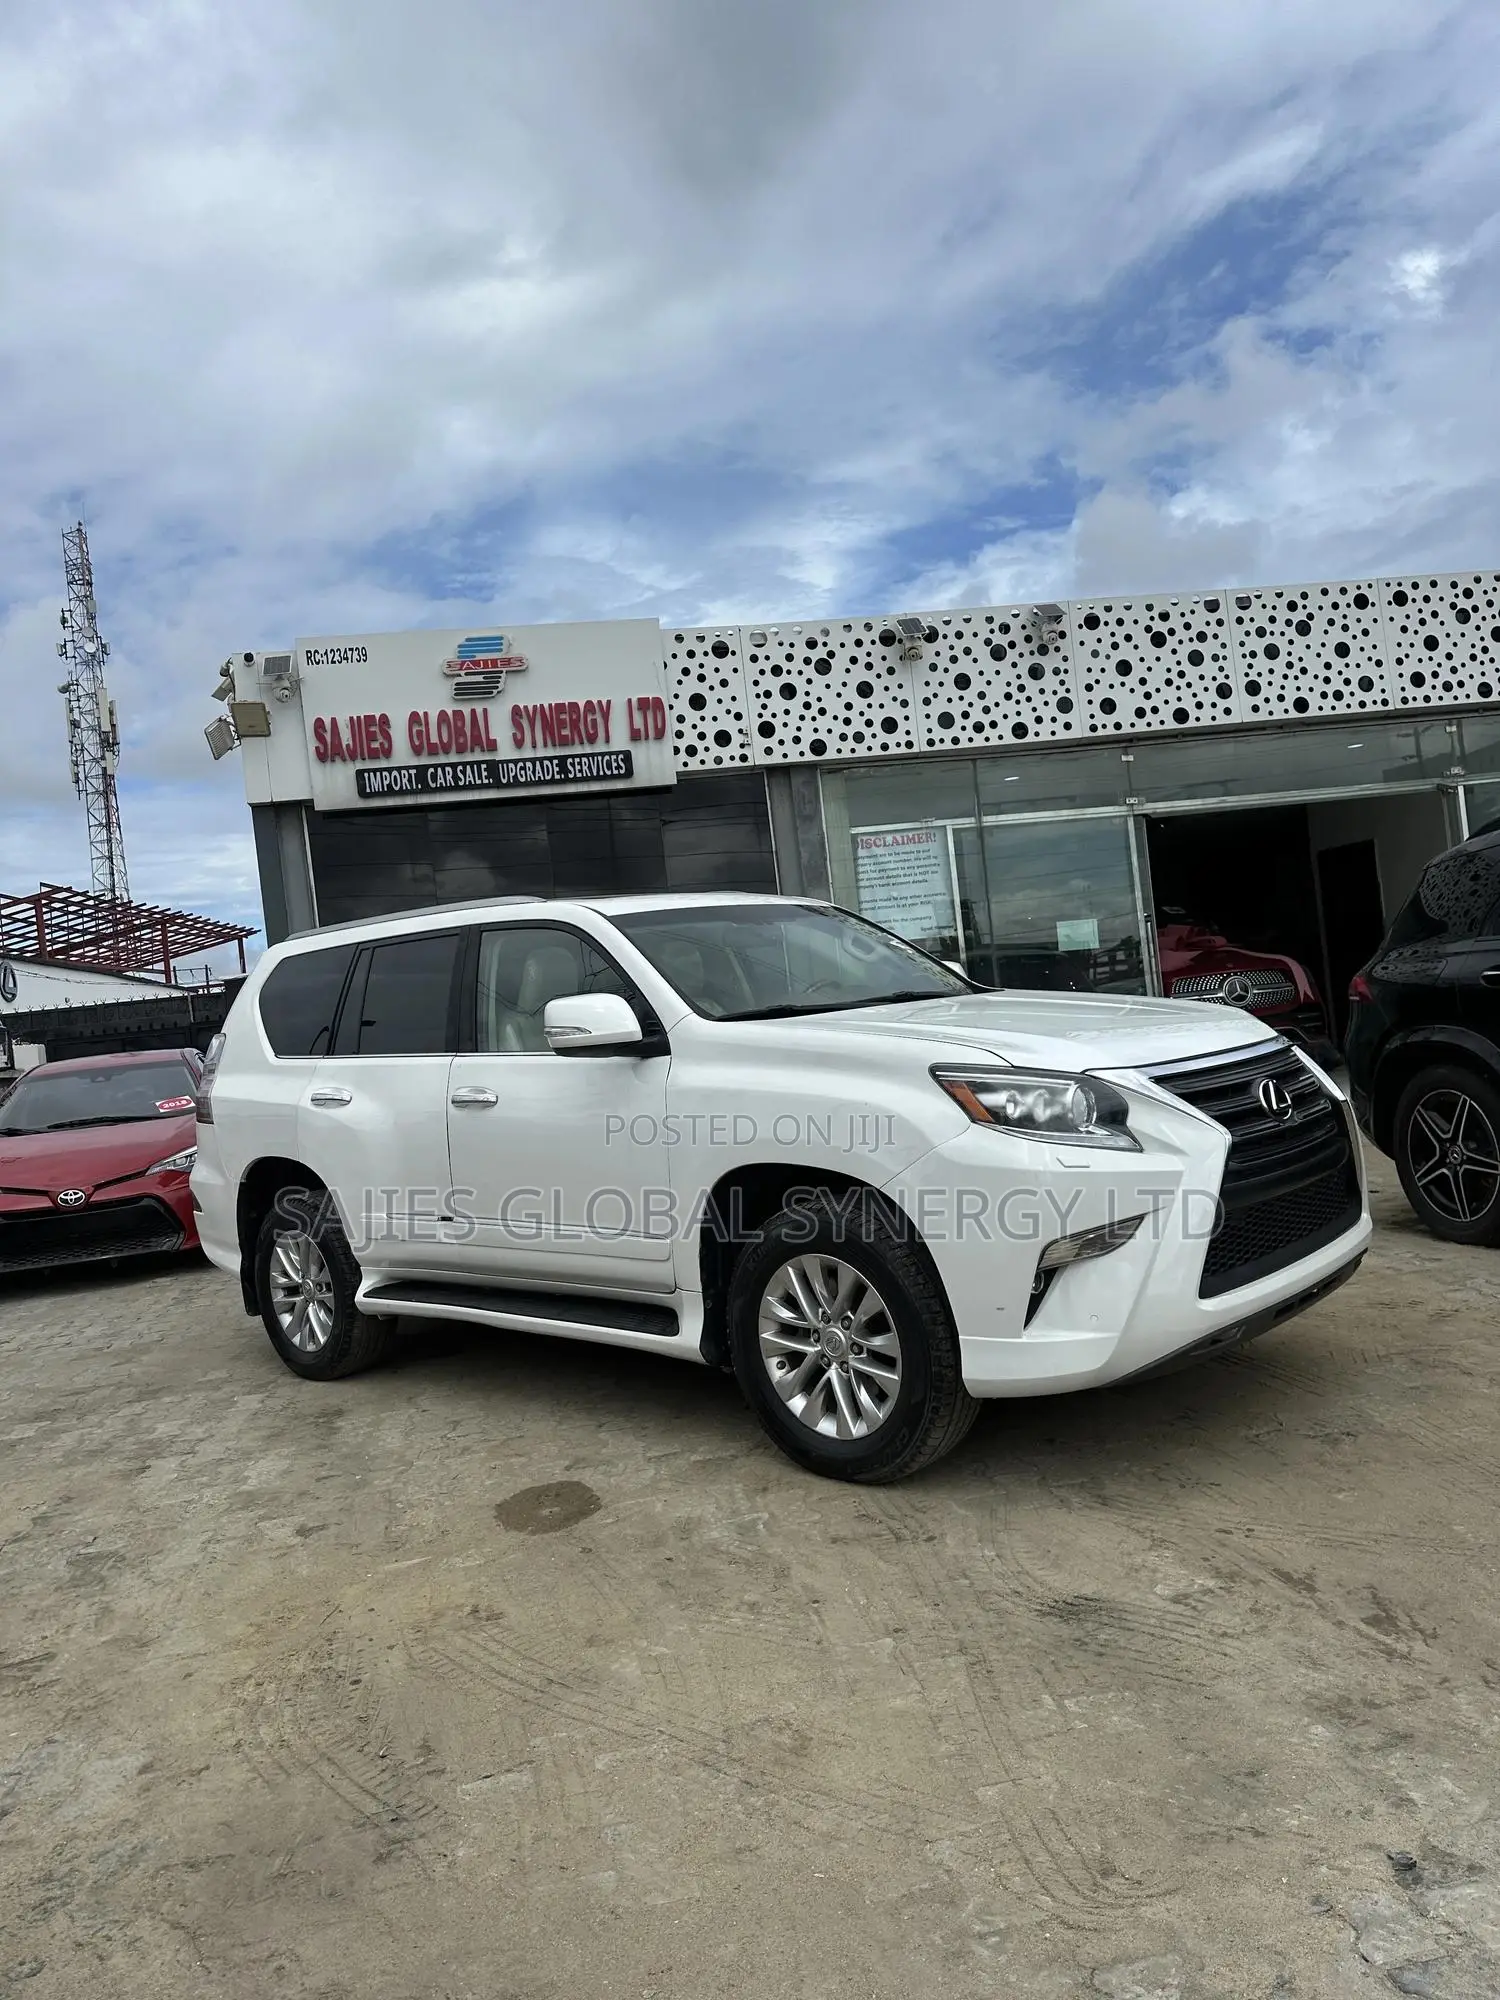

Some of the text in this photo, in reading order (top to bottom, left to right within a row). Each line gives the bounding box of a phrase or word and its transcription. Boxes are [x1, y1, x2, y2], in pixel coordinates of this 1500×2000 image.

[305, 646, 369, 666] RC:1234739
[445, 656, 525, 671] SAJIES
[313, 696, 666, 763] SAJIES GLOBAL SYNERGY LTD
[363, 754, 626, 794] IMPORT. CAR SALE. UPGRADE. SERVICES
